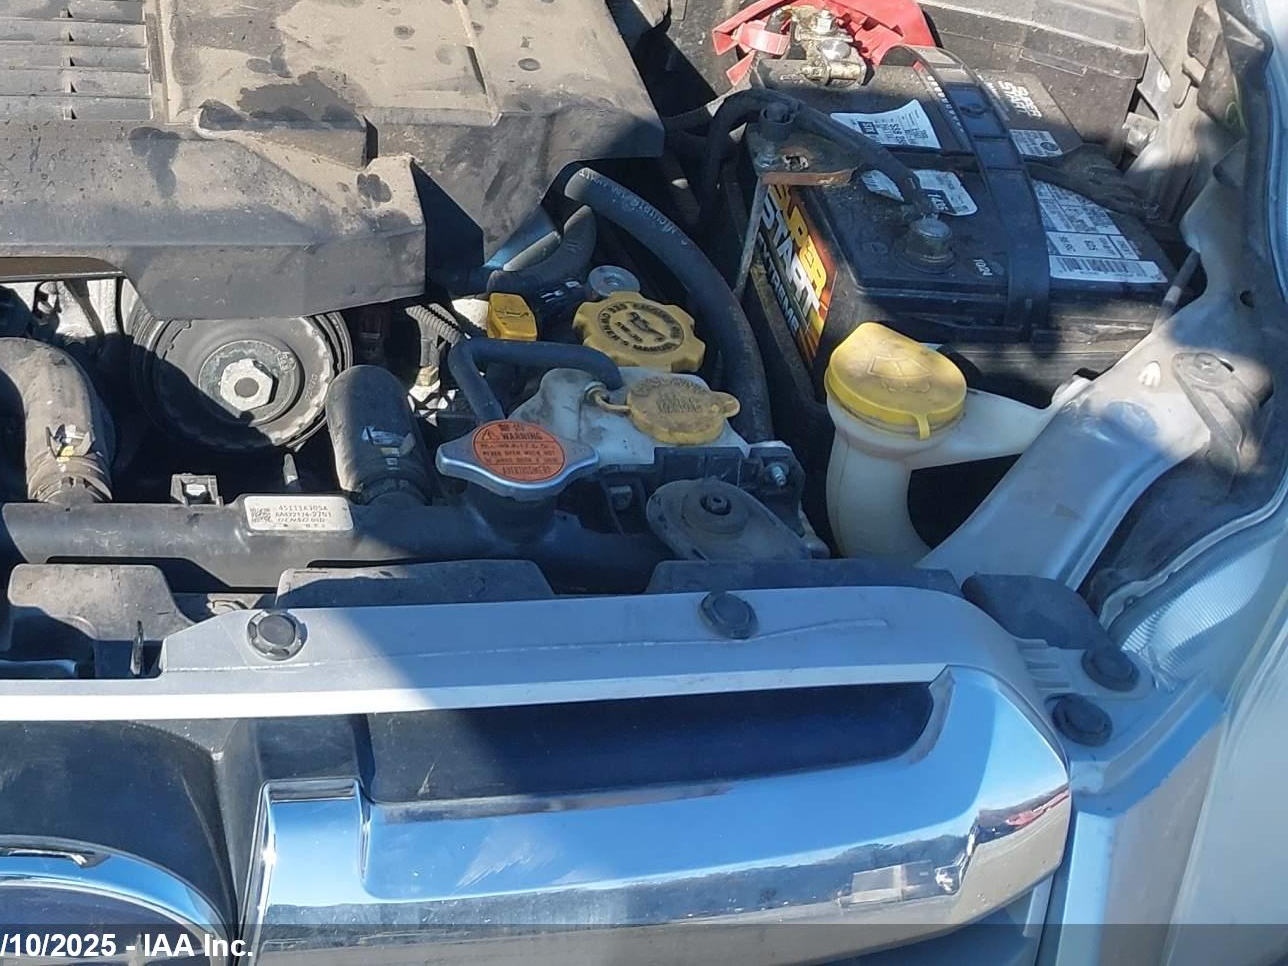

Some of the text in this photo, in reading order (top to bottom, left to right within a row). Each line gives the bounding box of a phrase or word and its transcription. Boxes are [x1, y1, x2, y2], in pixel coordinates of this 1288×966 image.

[997, 80, 1031, 117] START
[763, 191, 820, 318] START
[758, 232, 800, 332] EXTREME
[632, 341, 678, 352] MANUAL
[502, 432, 543, 440] WARNING
